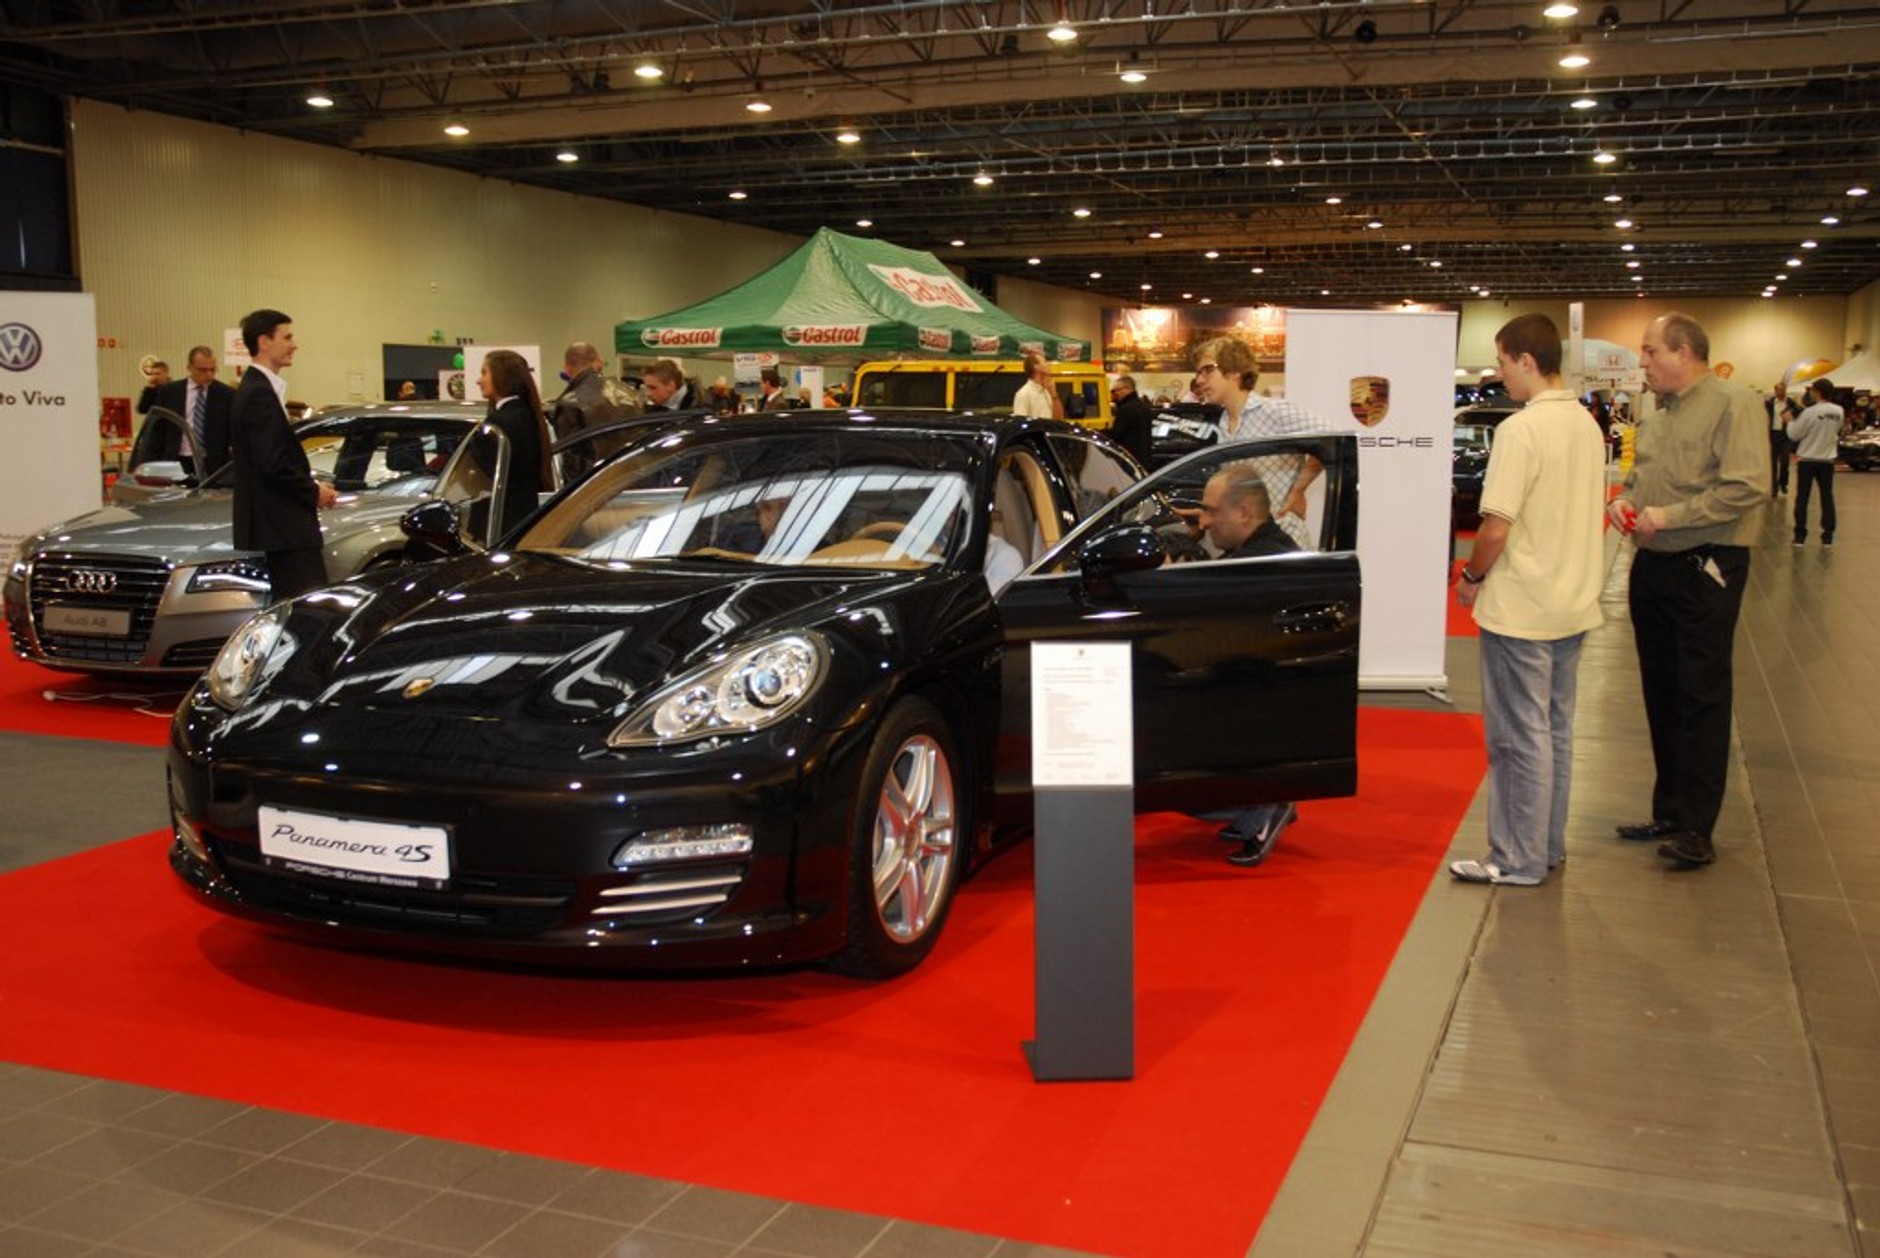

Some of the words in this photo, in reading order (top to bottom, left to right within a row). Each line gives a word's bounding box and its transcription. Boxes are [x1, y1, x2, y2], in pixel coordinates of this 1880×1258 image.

[892, 271, 973, 309] Castrol
[660, 328, 718, 346] Castrol
[802, 326, 861, 344] Castrol
[23, 390, 66, 406] Viva
[1359, 436, 1434, 448] SCHE
[63, 614, 90, 626] Audi
[271, 824, 388, 855] Panamera
[394, 844, 435, 863] 4S
